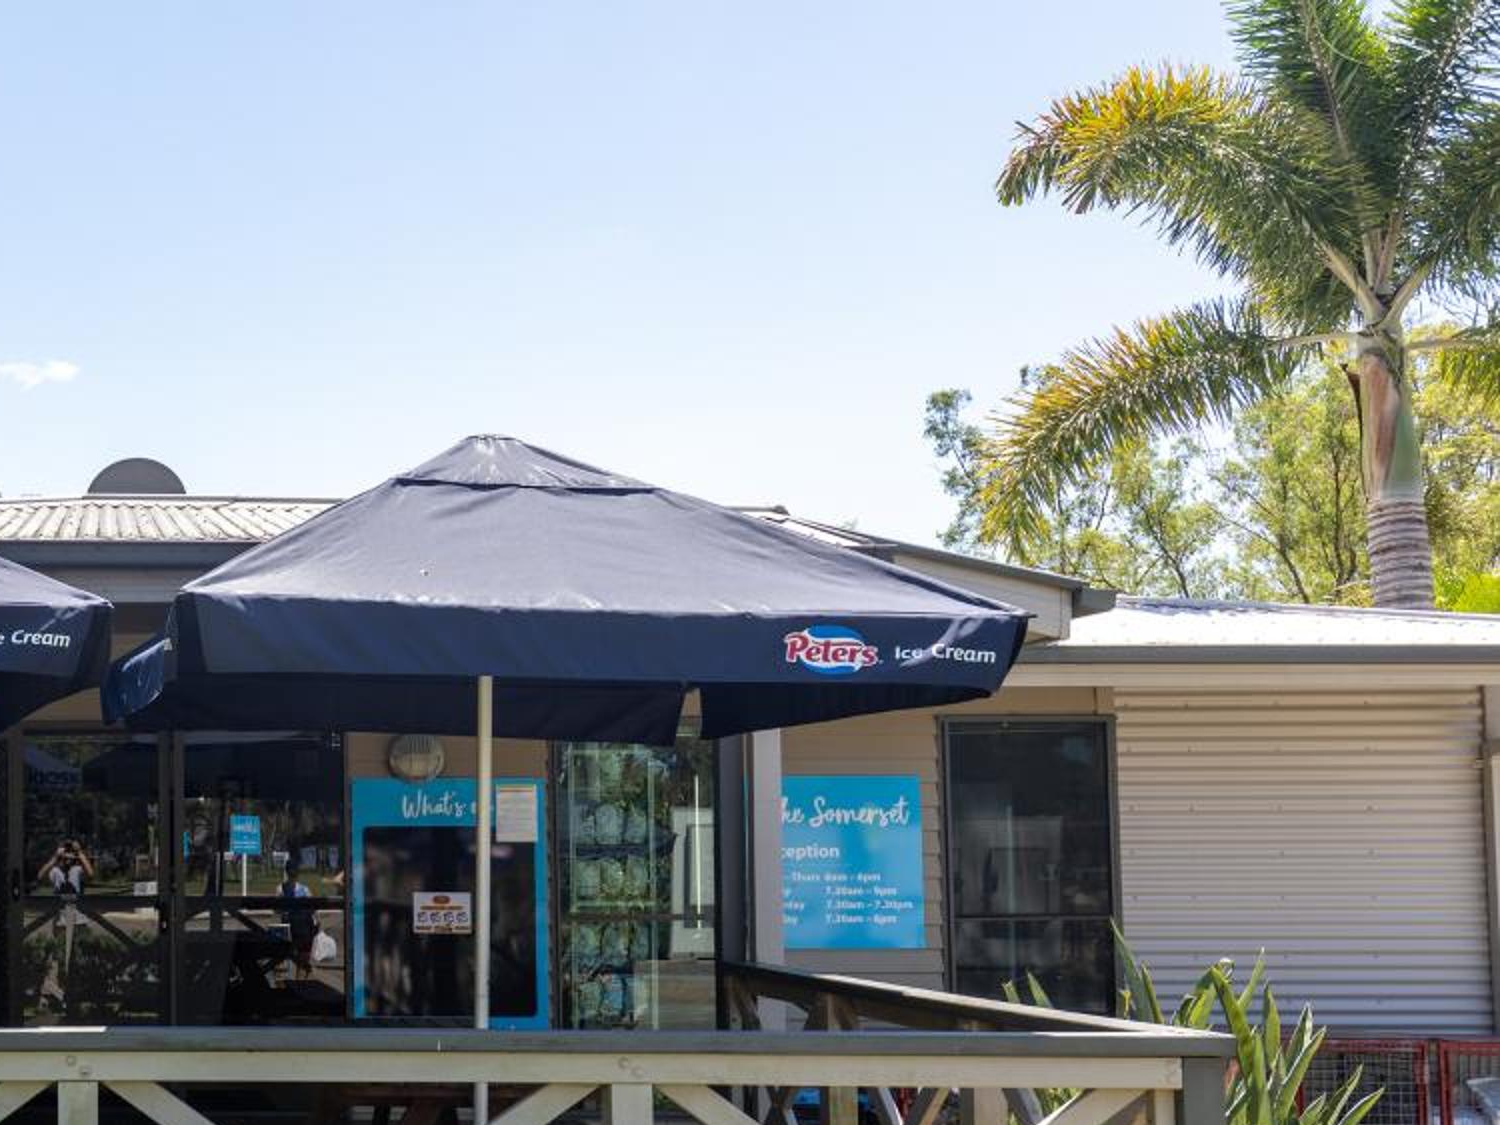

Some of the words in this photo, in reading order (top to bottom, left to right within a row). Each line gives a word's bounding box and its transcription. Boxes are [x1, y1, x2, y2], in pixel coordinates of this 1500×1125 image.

[12, 629, 71, 648] Cream
[784, 629, 879, 667] Peters
[931, 643, 997, 665] Cream
[402, 789, 466, 819] What's
[780, 796, 804, 824] he
[809, 796, 910, 827] Somerset
[781, 843, 840, 860] eption
